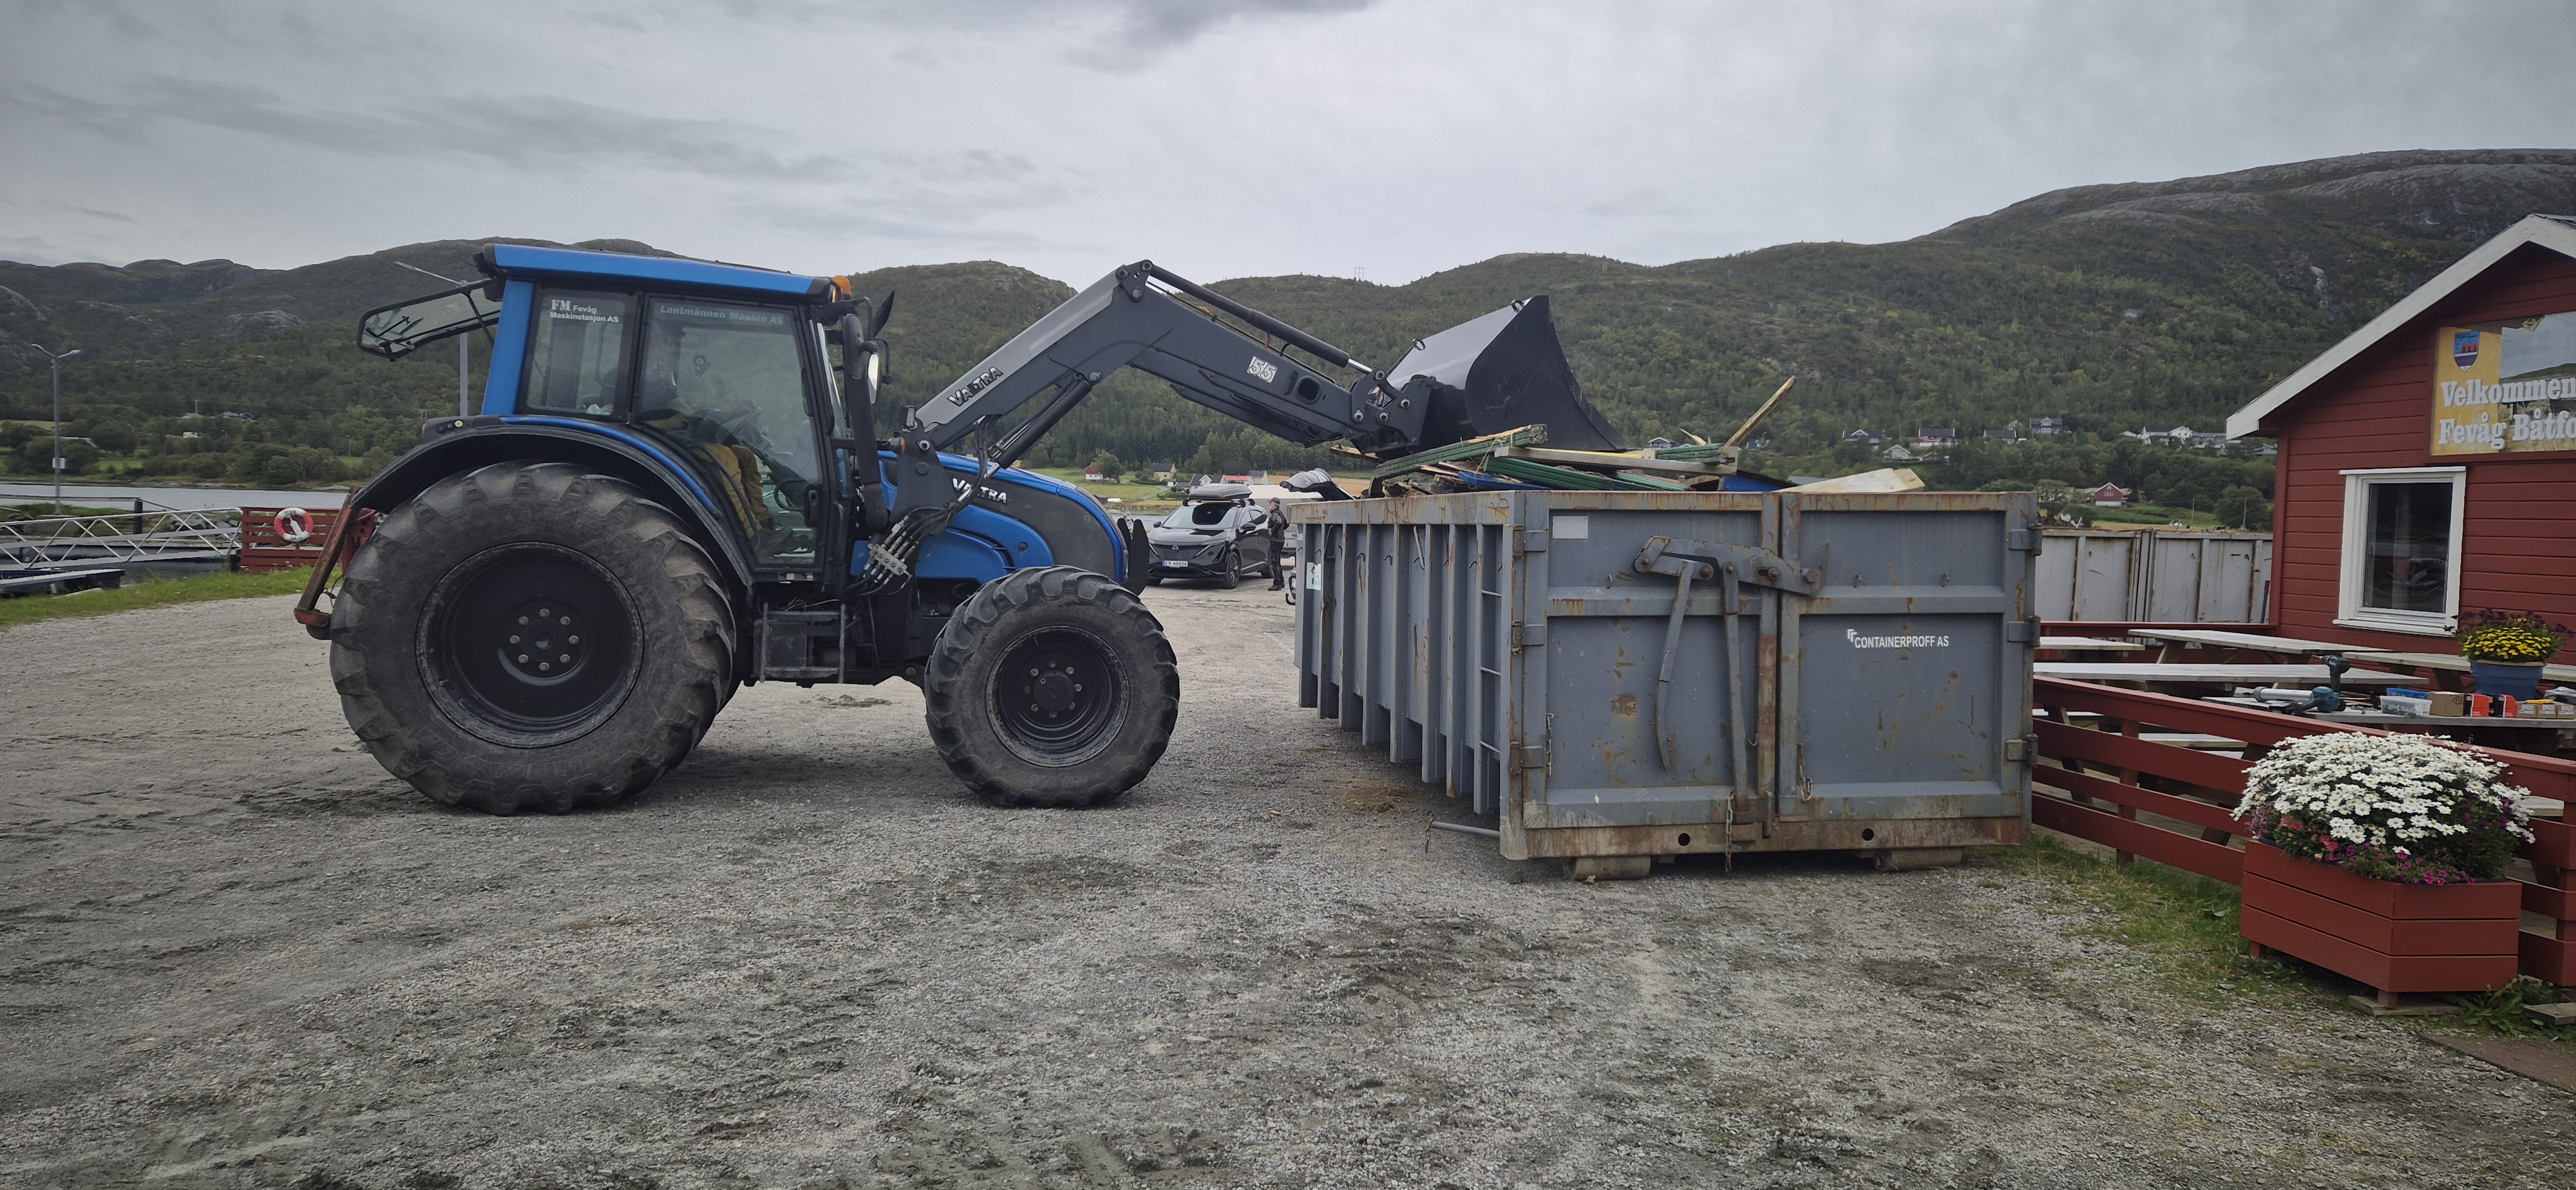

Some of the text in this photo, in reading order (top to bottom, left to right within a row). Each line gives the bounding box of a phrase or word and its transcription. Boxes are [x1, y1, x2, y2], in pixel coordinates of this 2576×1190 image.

[549, 312, 606, 322] Maskinstasjon
[551, 299, 597, 314] FM Fevåg
[660, 305, 784, 325] Lantmännen Maskin AS
[1248, 357, 1277, 381] 55
[947, 366, 1004, 407] VALTRA
[2441, 377, 2576, 407] Velkommen
[2438, 411, 2507, 450] Fevåg
[952, 477, 1007, 504] VATRA
[1854, 635, 1949, 648] CONTAINERPROFF AS
